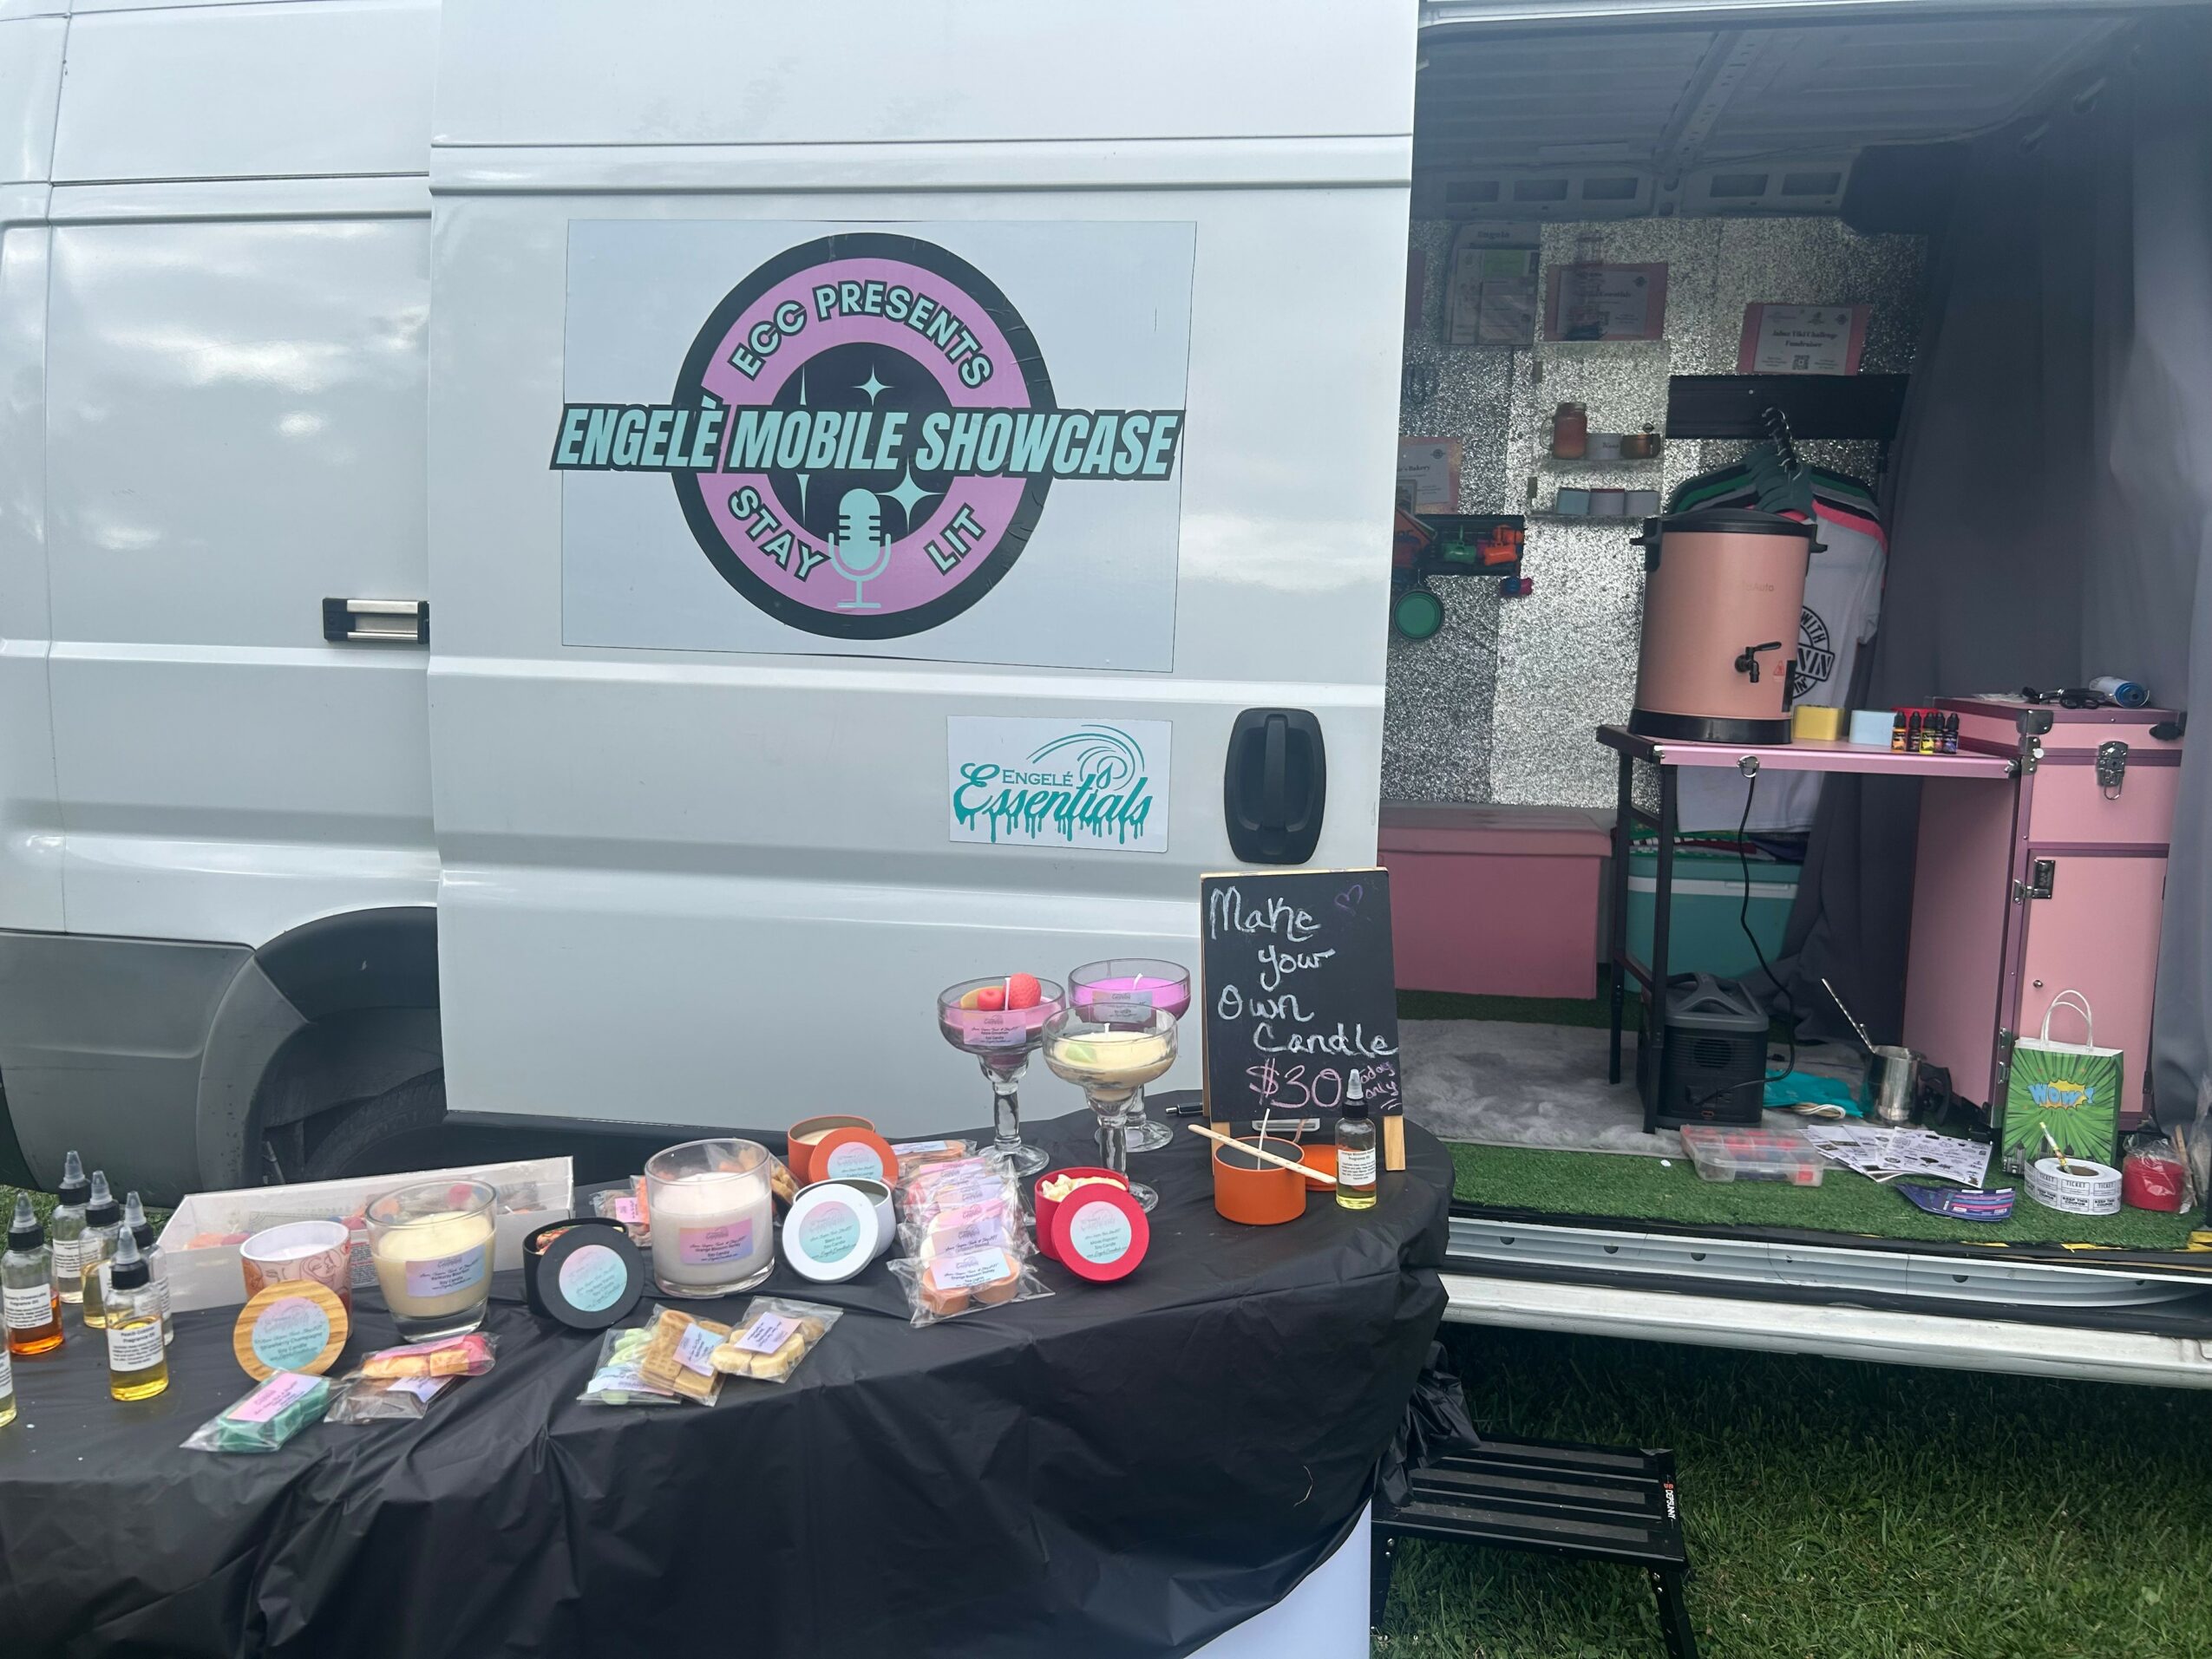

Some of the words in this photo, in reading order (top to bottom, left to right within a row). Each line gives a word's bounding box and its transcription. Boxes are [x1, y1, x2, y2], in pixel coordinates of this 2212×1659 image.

[814, 282, 993, 388] PRESENTS
[729, 409, 911, 472] MOBILE
[916, 410, 1178, 476] SHOWCASE
[730, 487, 827, 580] STAY
[926, 505, 984, 573] LIT
[952, 761, 1155, 841] Essentials
[1209, 885, 1322, 942] Make
[1217, 983, 1315, 1022] Own
[1253, 1022, 1399, 1059] Candle
[1246, 1057, 1343, 1110] $30
[1365, 1081, 1400, 1101] only
[2039, 1172, 2055, 1183] TICKET
[2065, 1179, 2086, 1188] TICKET
